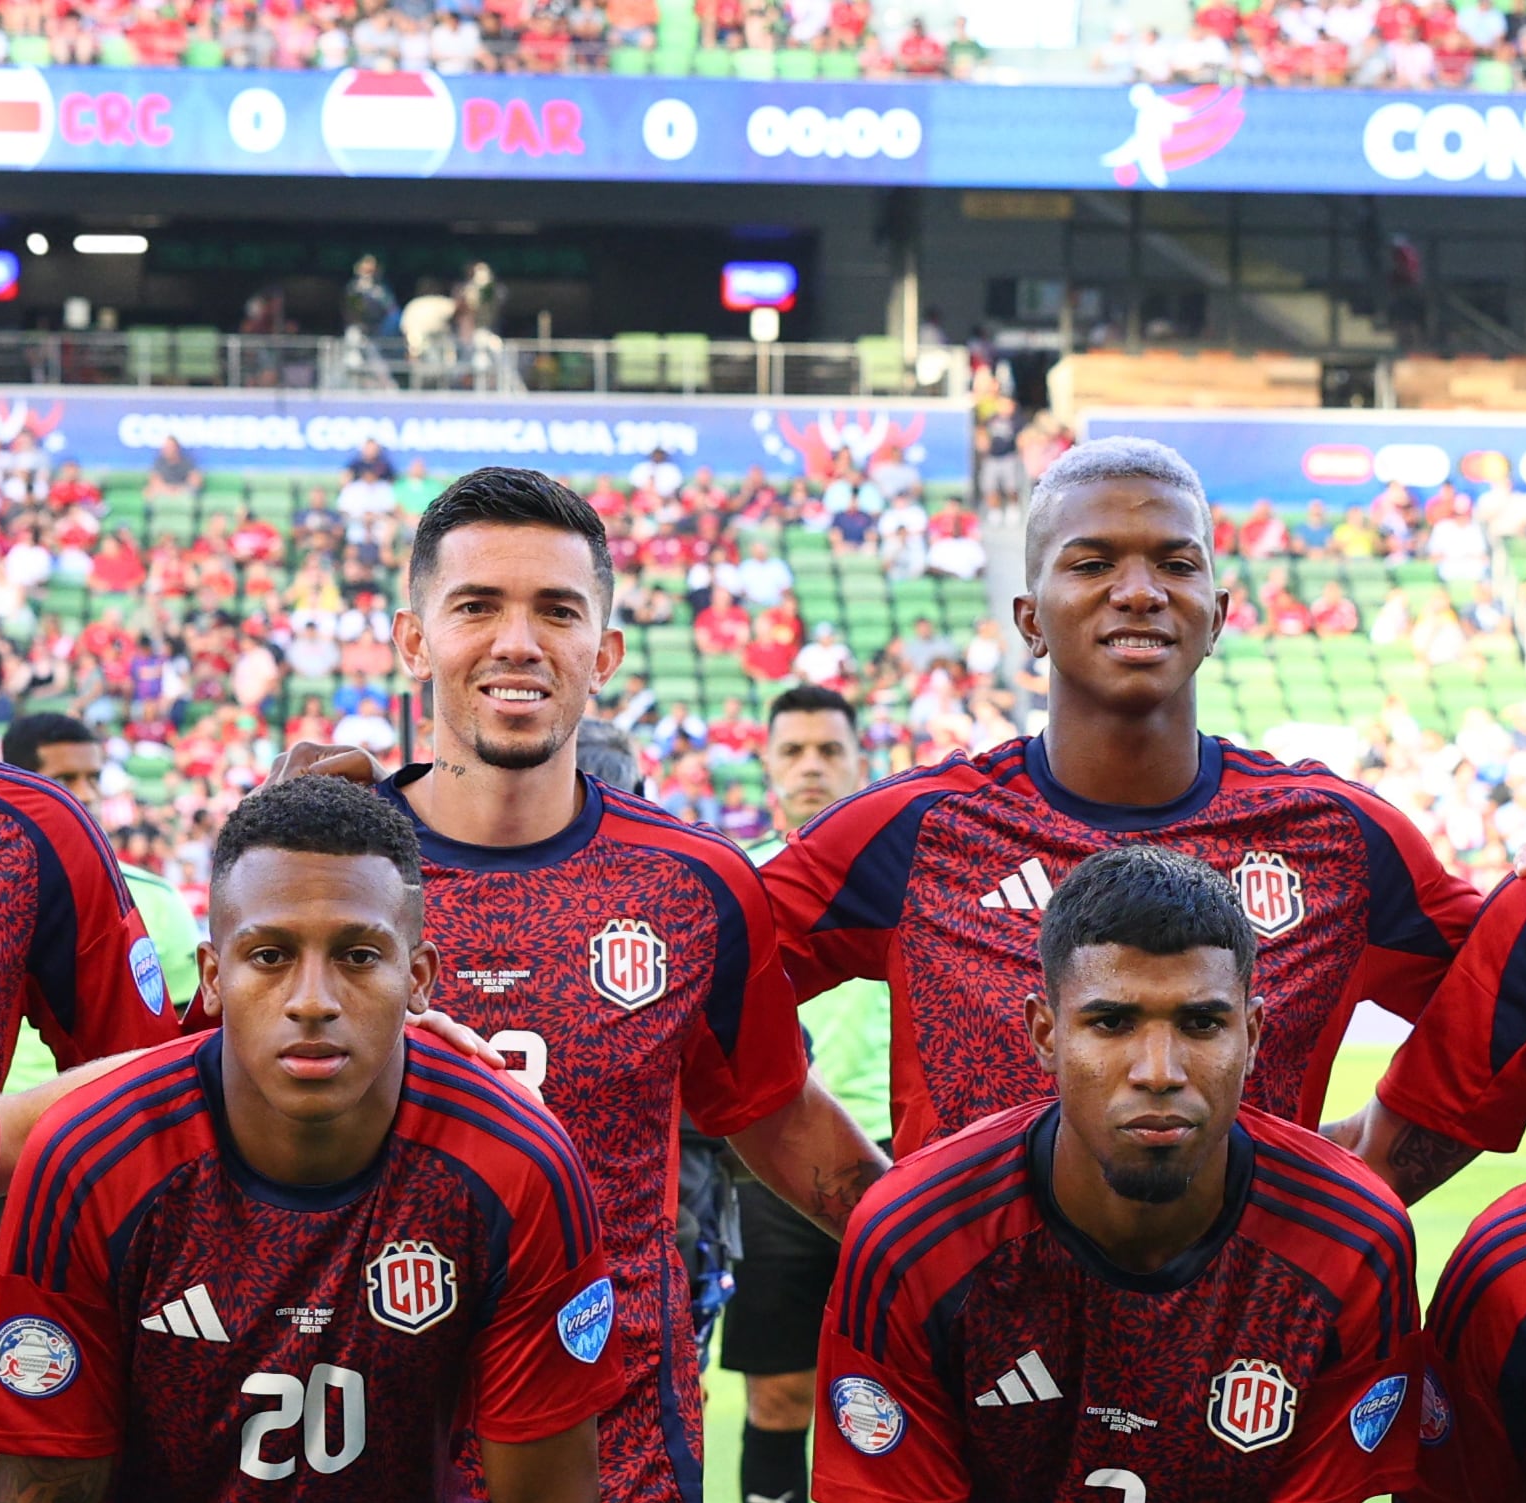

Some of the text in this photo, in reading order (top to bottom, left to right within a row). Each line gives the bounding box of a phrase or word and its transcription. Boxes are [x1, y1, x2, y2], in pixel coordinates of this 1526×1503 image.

[59, 88, 923, 162] CRC 0 PAR 0 00:00
[118, 413, 305, 450] CONMEBOL
[306, 416, 401, 452] COPA
[399, 418, 548, 454] AMERICA
[1246, 869, 1286, 922] CR
[608, 938, 648, 993] CR
[276, 1308, 295, 1316] COSTA
[388, 1258, 437, 1316] CR
[567, 1296, 607, 1333] VIBRA
[240, 1363, 366, 1481] 20
[1087, 1407, 1105, 1415] COSTA
[1227, 1377, 1277, 1433] CR
[1356, 1391, 1400, 1418] VIBRA
